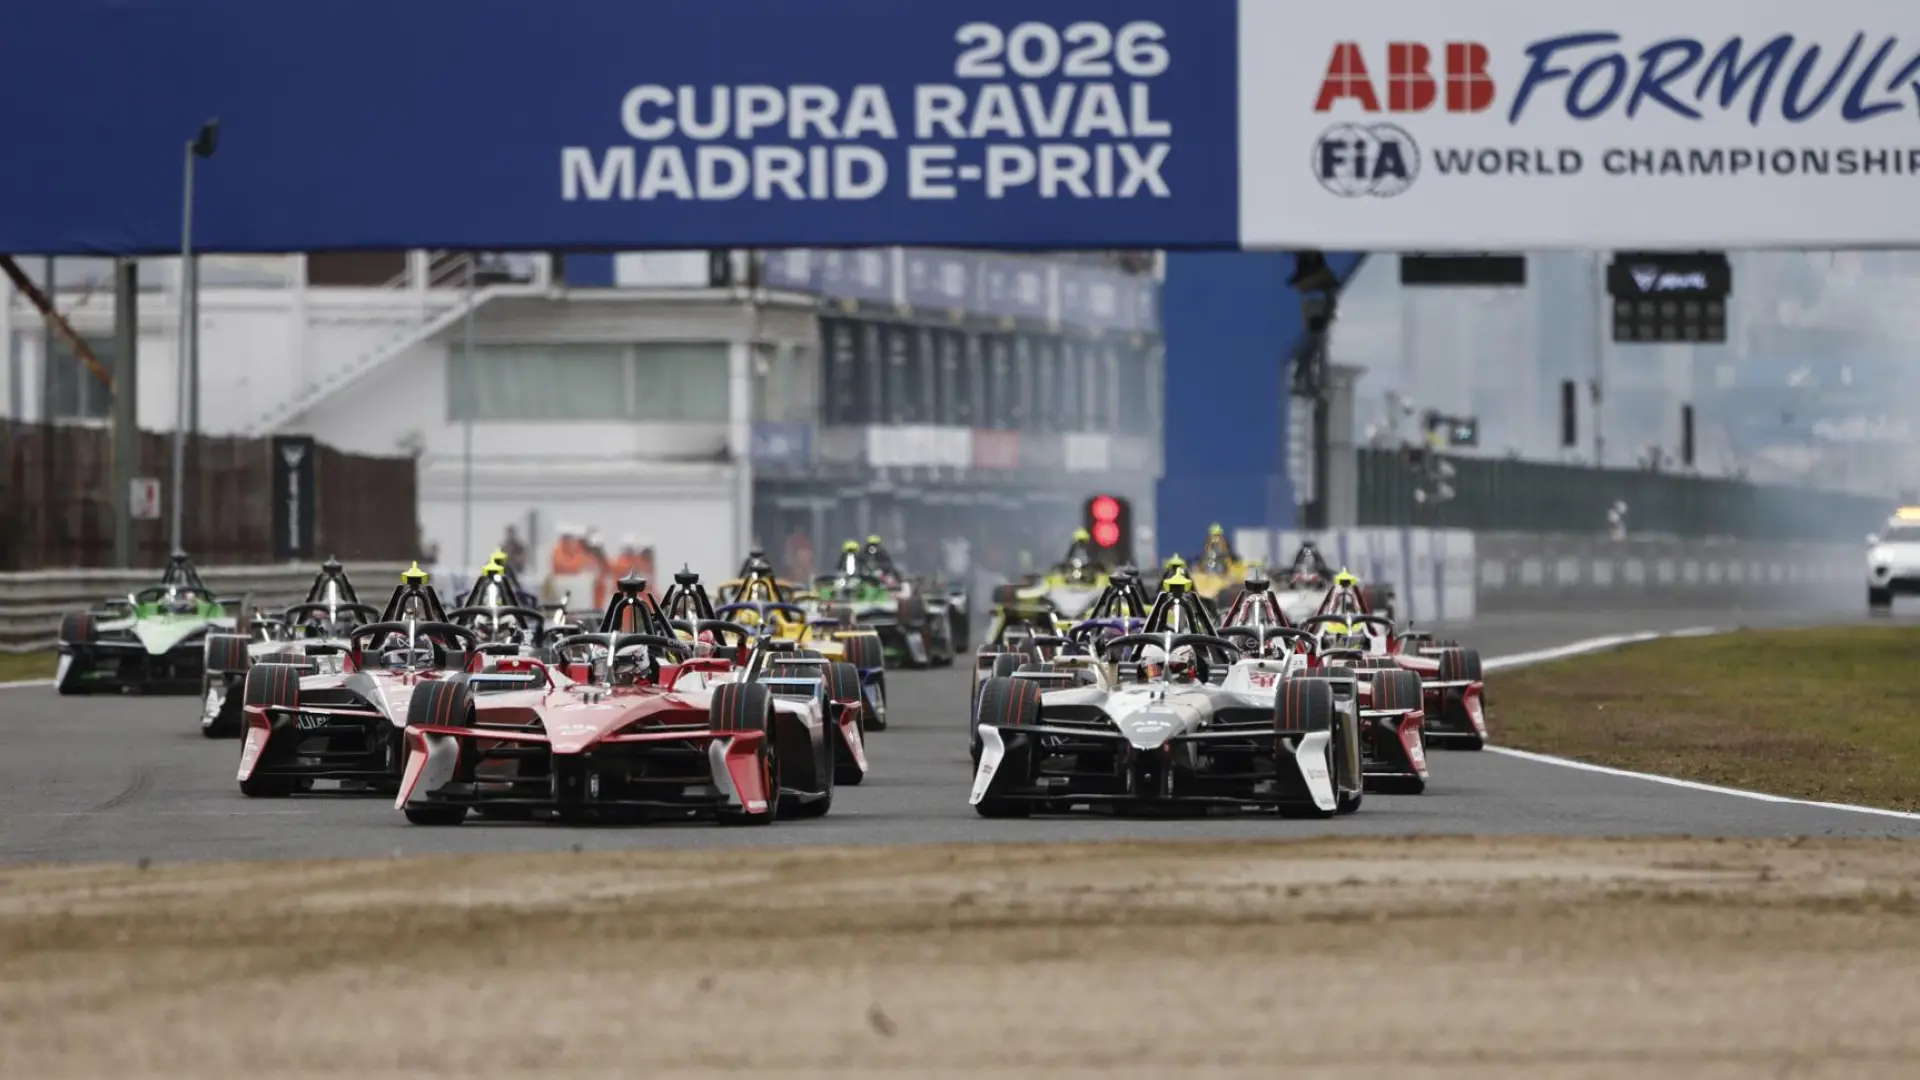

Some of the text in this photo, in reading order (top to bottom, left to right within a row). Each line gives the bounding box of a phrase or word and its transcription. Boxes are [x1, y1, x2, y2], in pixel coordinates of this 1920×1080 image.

[953, 21, 1170, 77] 2026
[1314, 42, 1495, 113] ABB
[621, 82, 1171, 139] CUPRA RAVAL
[561, 143, 1171, 200] MADRID E-PRIX
[1433, 147, 1584, 175] WORLD
